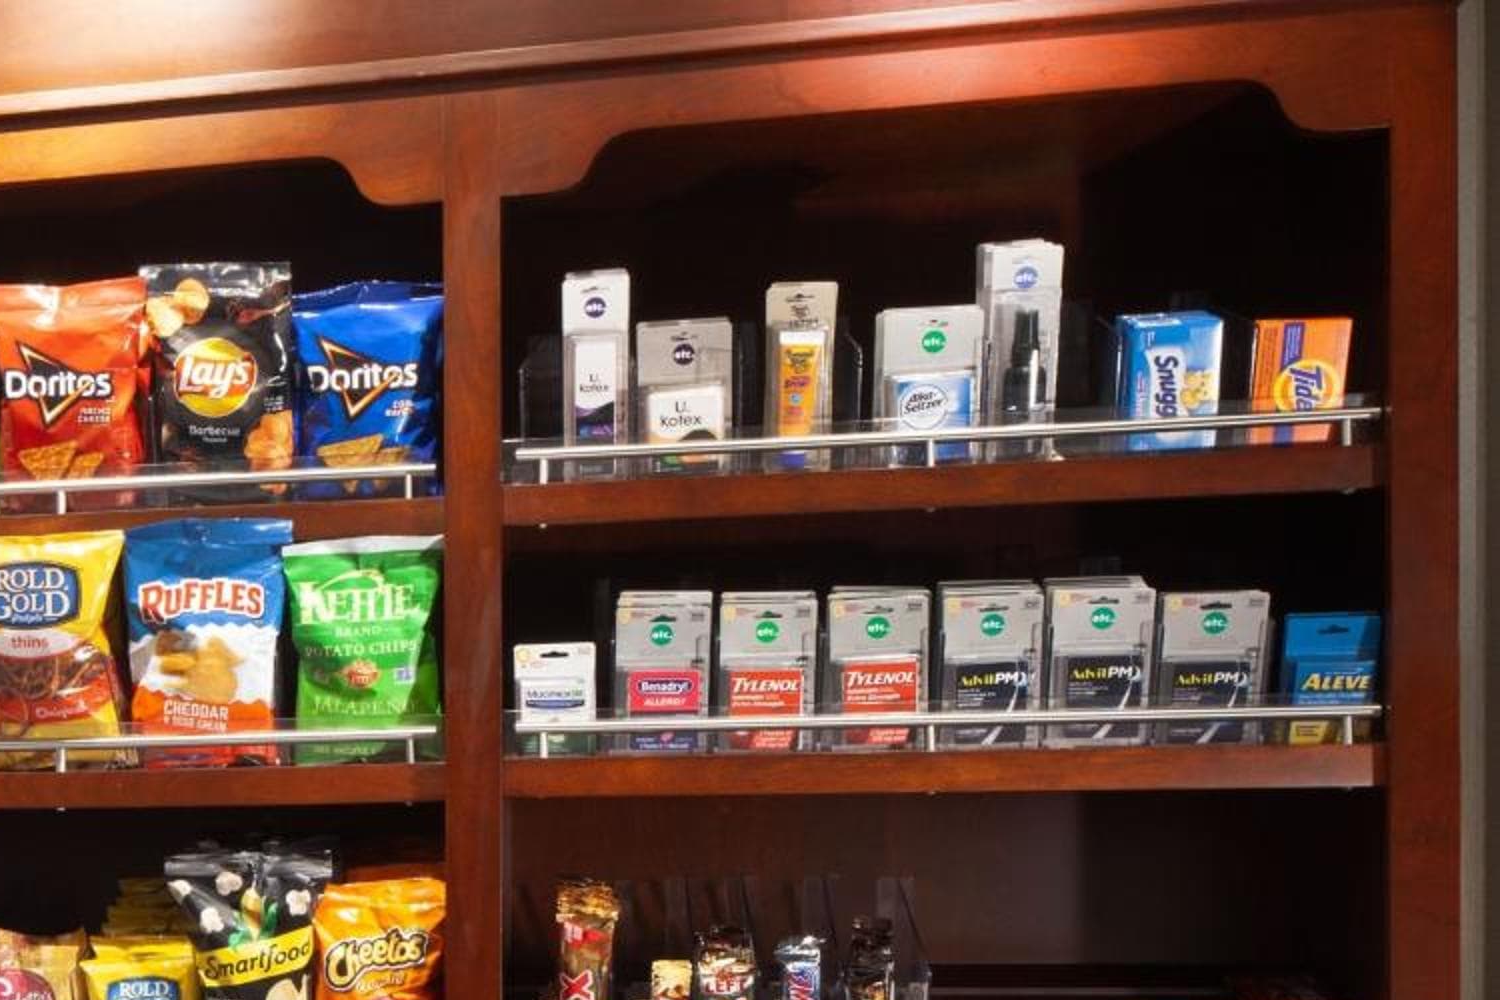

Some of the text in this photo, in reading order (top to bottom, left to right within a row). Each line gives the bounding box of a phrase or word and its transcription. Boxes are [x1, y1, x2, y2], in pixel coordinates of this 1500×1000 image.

[5, 370, 112, 398] Doritos
[308, 363, 418, 392] Doritos
[660, 413, 702, 427] kotex
[139, 579, 264, 624] RUFFLES
[10, 636, 49, 649] thins
[846, 671, 915, 687] TYLENOL
[996, 671, 1019, 685] PM
[1107, 665, 1132, 679] PM
[1214, 670, 1239, 684] PM
[639, 680, 691, 694] Benadryl
[732, 678, 799, 694] TYLENOL
[1302, 673, 1371, 690] ALEVE
[163, 700, 229, 718] CHEDDAR
[203, 942, 311, 980] Smartfood
[326, 928, 427, 989] Cheetos
[119, 981, 170, 999] ROLD
